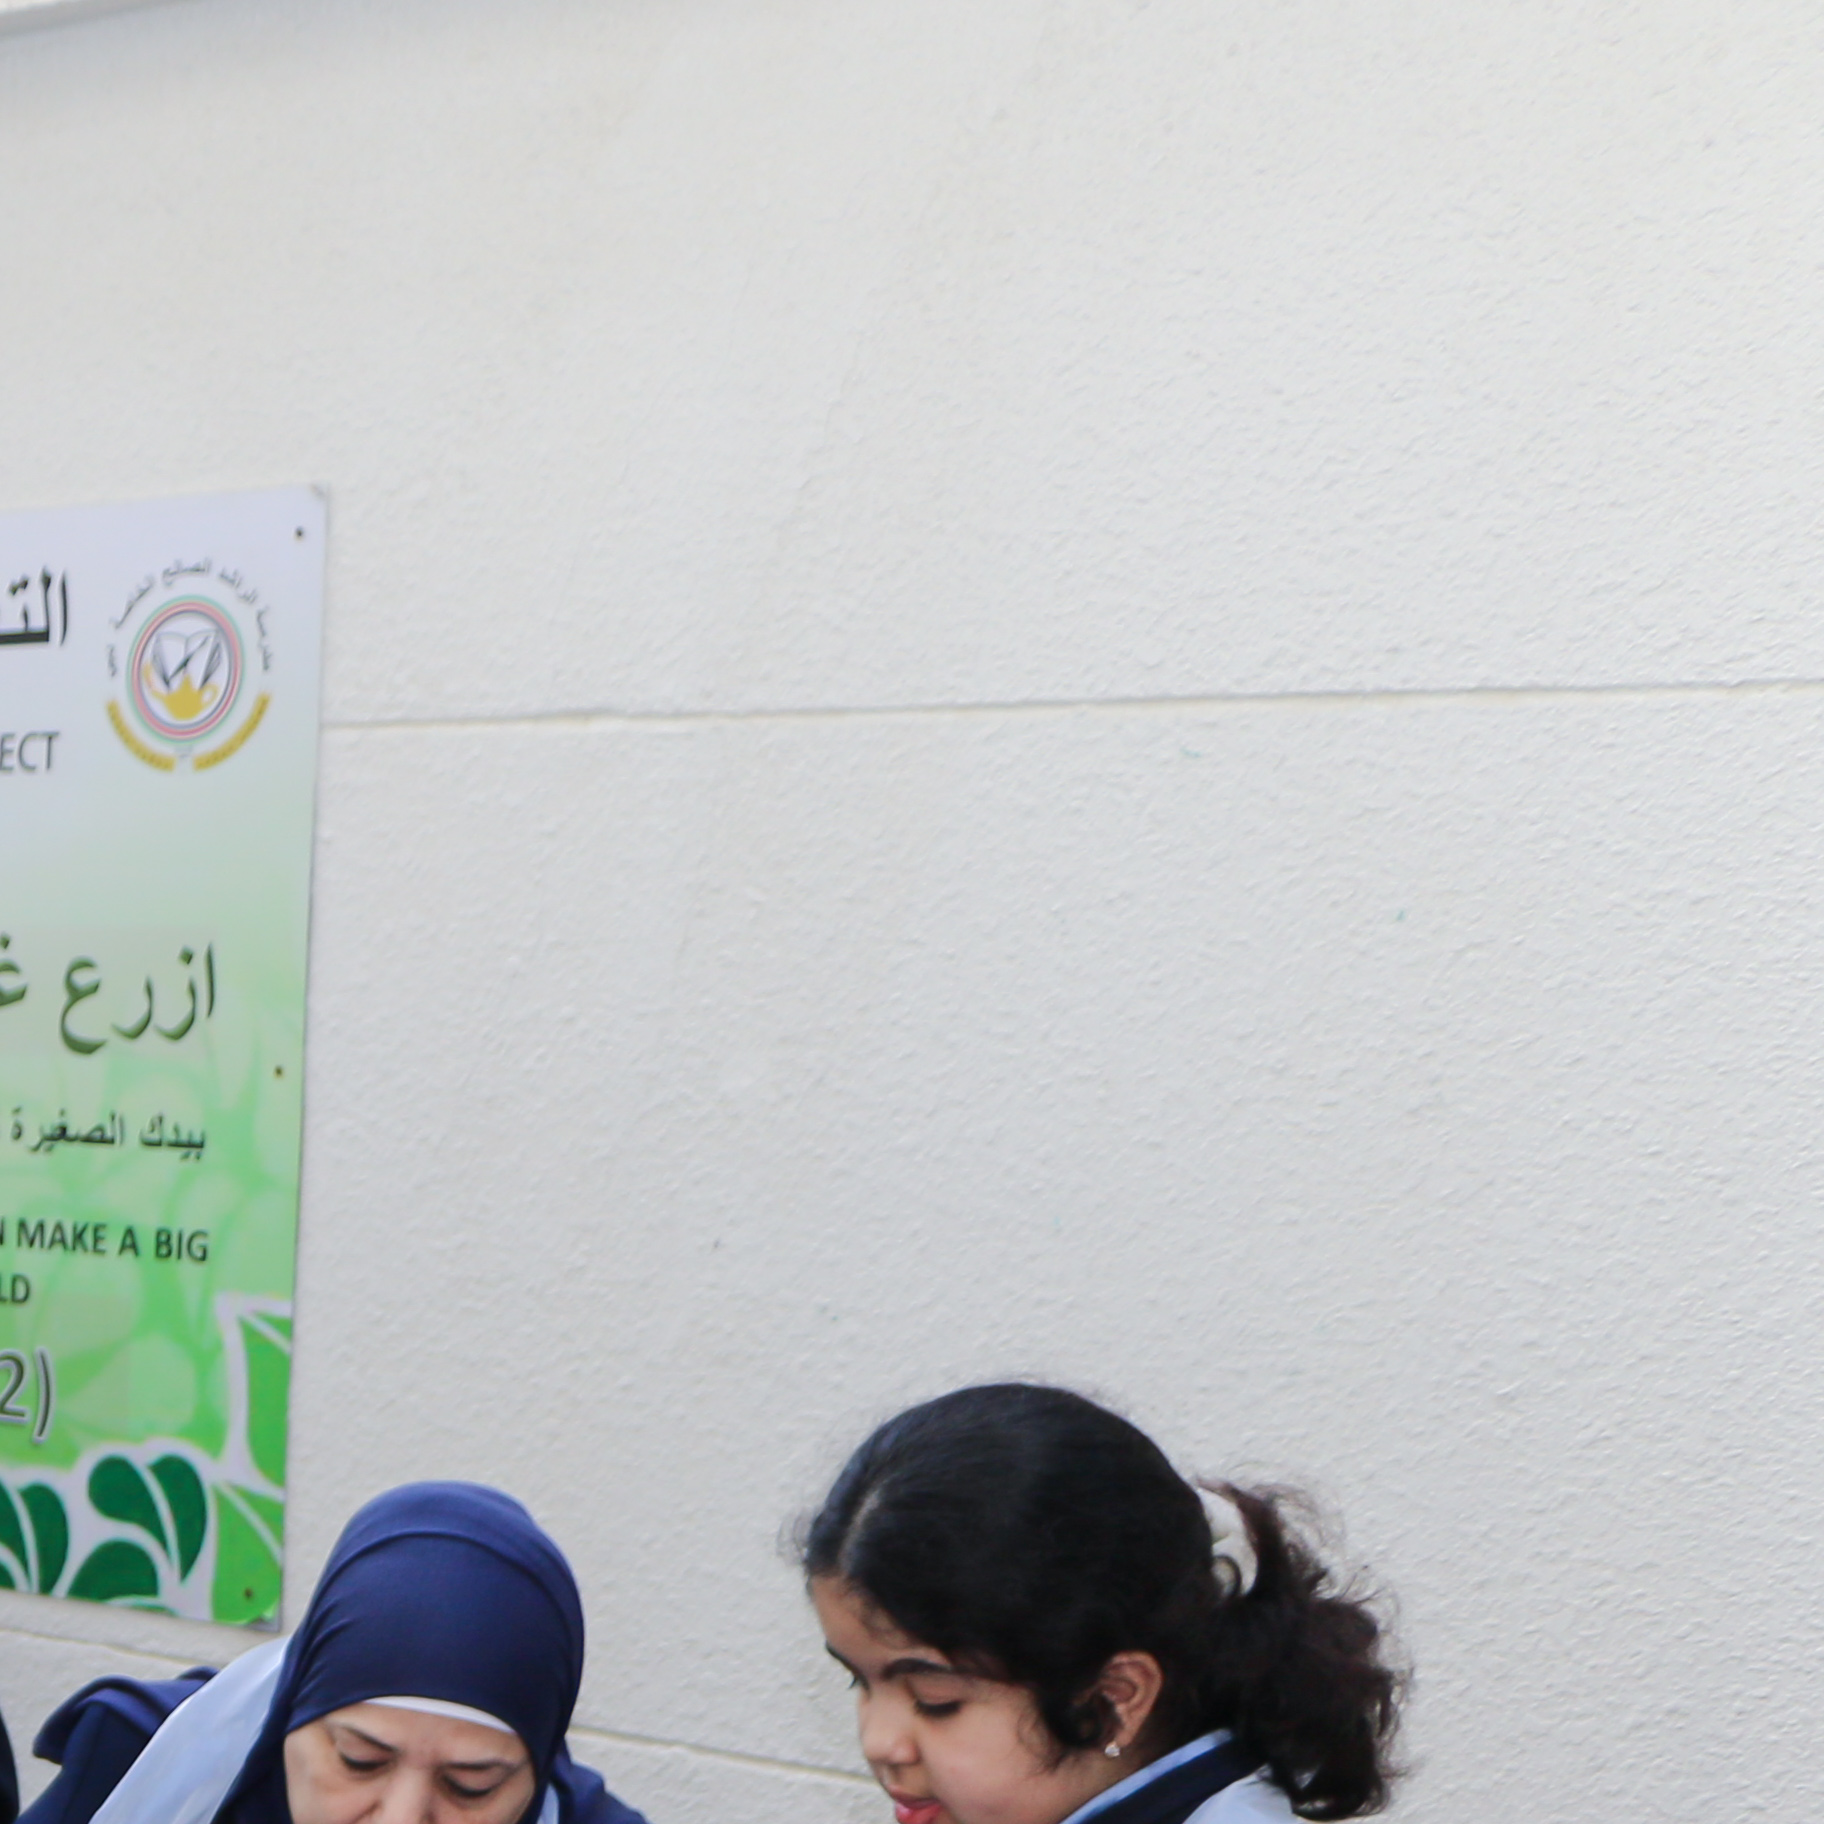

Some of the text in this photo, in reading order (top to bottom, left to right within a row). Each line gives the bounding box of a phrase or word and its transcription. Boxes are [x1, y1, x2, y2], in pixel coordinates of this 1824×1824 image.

[59, 941, 215, 1055] ازرع
[11, 1105, 125, 1153] الصغيرة
[140, 1111, 206, 1162] بيدك
[17, 1217, 108, 1254] MAKE
[118, 1225, 141, 1258] A
[155, 1227, 210, 1263] BIG
